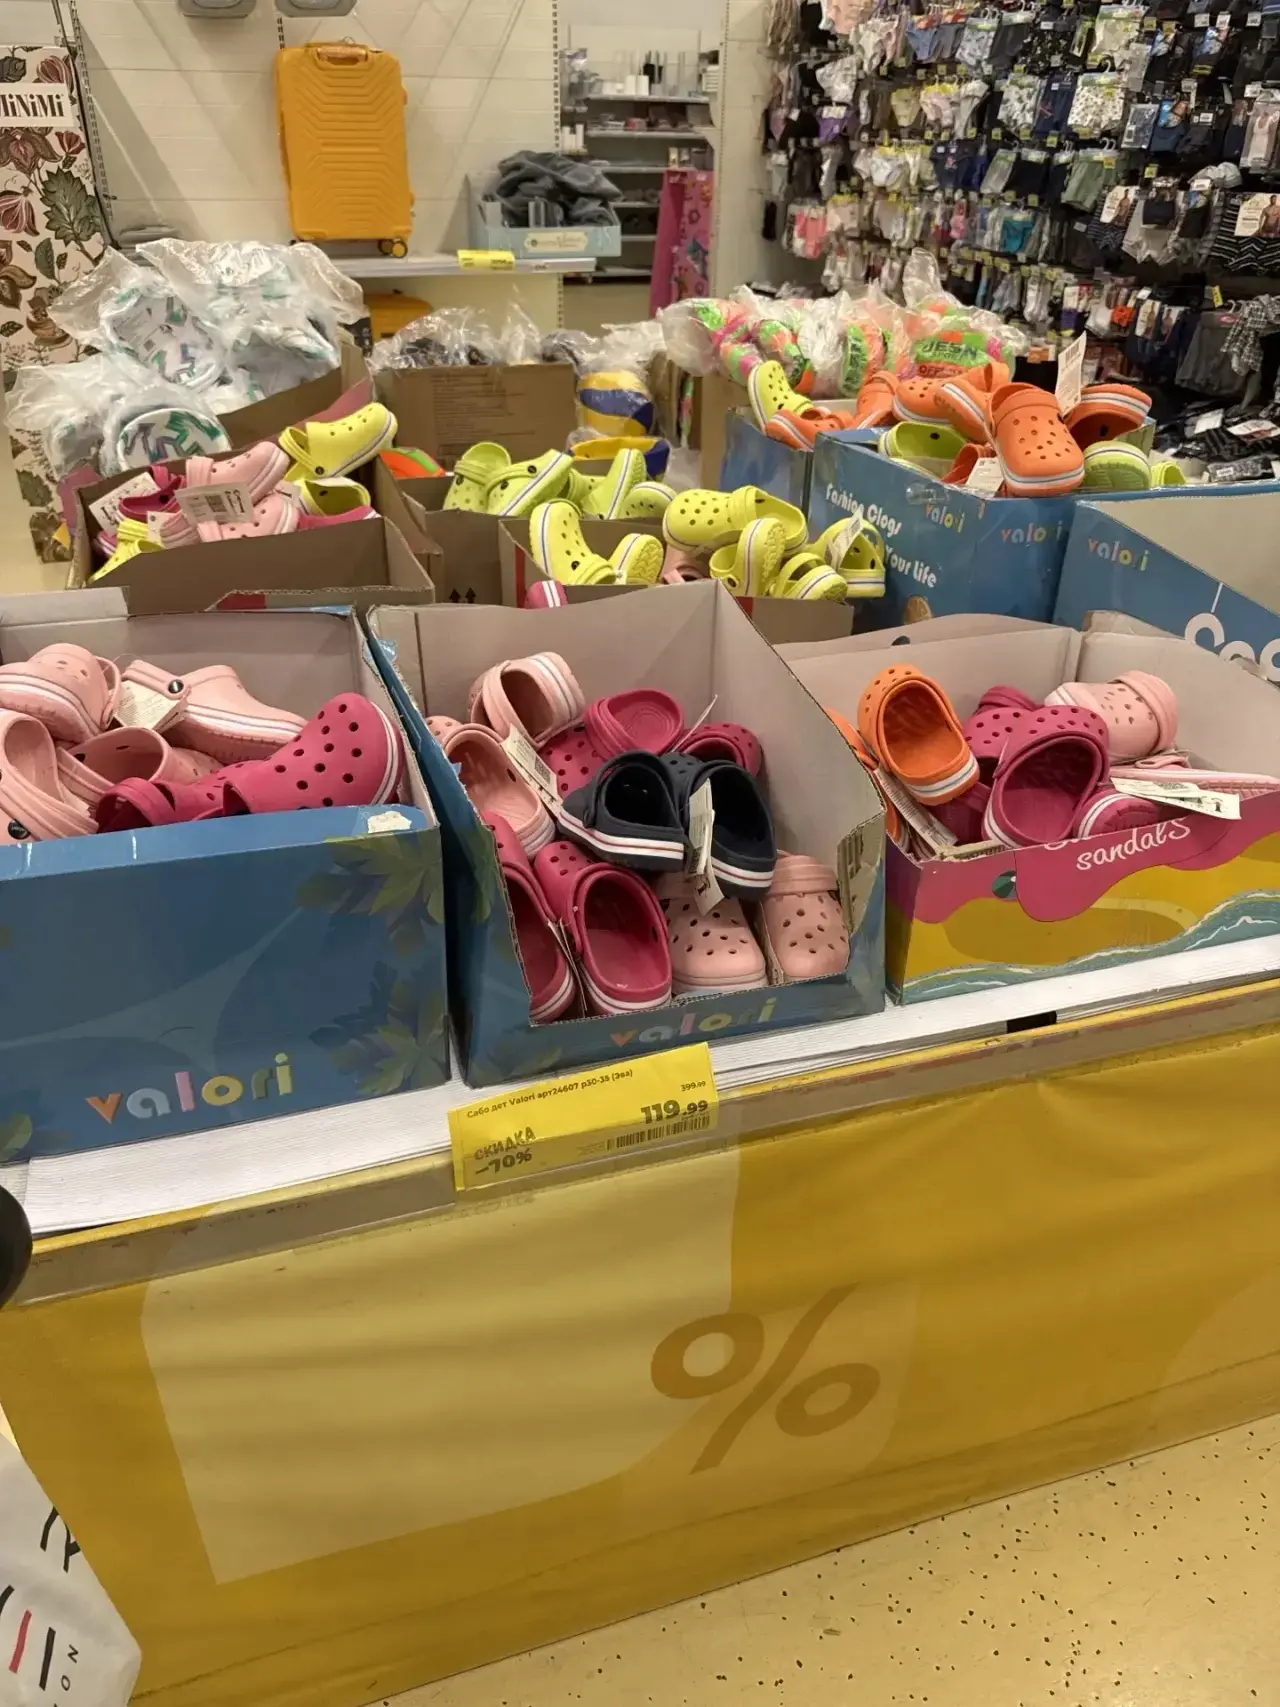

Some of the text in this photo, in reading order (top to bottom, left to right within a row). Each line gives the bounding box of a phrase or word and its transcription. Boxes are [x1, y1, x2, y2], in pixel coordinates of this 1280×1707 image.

[867, 504, 903, 537] Clogs
[1001, 520, 1063, 543] valoi
[885, 545, 912, 575] Your
[1076, 817, 1191, 870] sandals
[610, 997, 777, 1047] valori
[84, 1052, 293, 1124] valori
[467, 1106, 490, 1119] Сабо
[491, 1101, 508, 1112] дет
[509, 1091, 536, 1106] Valori
[537, 1082, 579, 1100] арт24607
[641, 1099, 709, 1124] 119.99
[474, 1126, 537, 1161] СКИДКА
[651, 1281, 881, 1475] %
